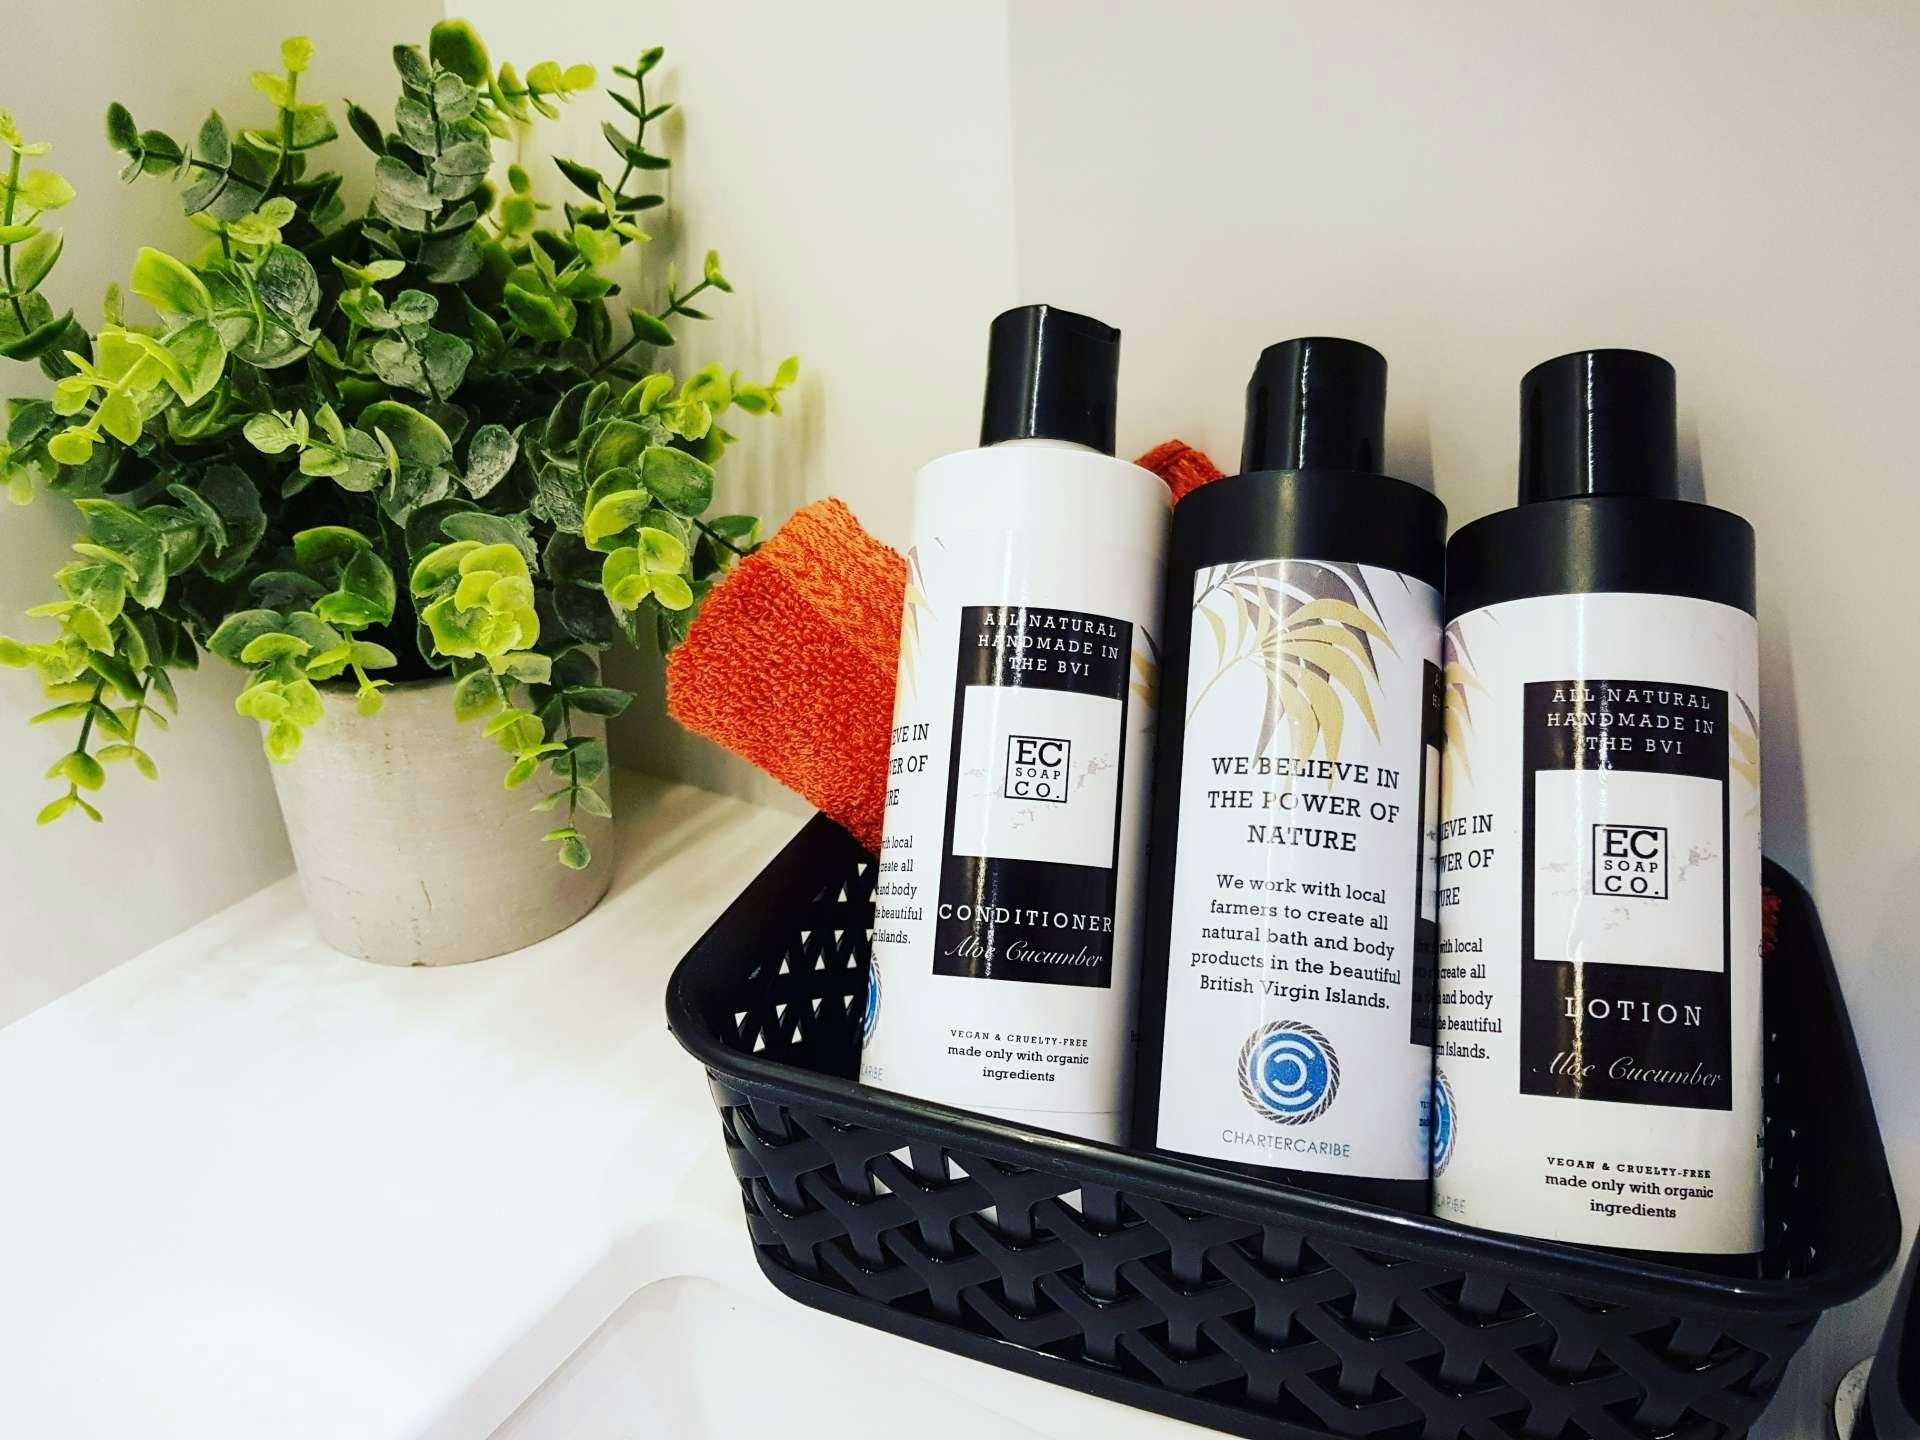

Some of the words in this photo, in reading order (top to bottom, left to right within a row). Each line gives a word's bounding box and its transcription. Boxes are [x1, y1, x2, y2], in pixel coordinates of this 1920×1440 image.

[984, 614, 1020, 627] ALL
[1030, 614, 1117, 637] NATURAL
[978, 635, 1093, 654] HANDMADE
[1102, 645, 1119, 659] IN
[1009, 657, 1047, 671] THE
[1057, 661, 1089, 676] BVI
[1552, 689, 1595, 703] ALL
[1607, 689, 1710, 709] NATURAL
[912, 724, 929, 741] IN
[1548, 713, 1684, 730] HANDMADE
[1695, 719, 1714, 734] IN
[1015, 740, 1062, 767] EC
[1586, 737, 1632, 751] THE
[1646, 739, 1682, 755] BVI
[907, 755, 928, 773] OF
[1015, 767, 1061, 780] SOAP
[1212, 757, 1249, 776] WE
[1257, 757, 1368, 784] BELIEVE
[1376, 768, 1400, 790] IN
[1014, 782, 1060, 799] CO.
[1207, 791, 1253, 809] THE
[1261, 792, 1361, 817] POWER
[1369, 802, 1400, 824] OF
[1472, 814, 1493, 834] IN
[891, 835, 912, 849] local
[1247, 824, 1357, 852] NATURE
[1603, 829, 1658, 859] EC
[900, 859, 913, 872] all
[1468, 849, 1494, 868] OF
[1604, 860, 1658, 873] SOAP
[891, 883, 917, 900] body
[1216, 874, 1244, 890] We
[1249, 873, 1297, 893] work
[1302, 881, 1341, 898] with
[1346, 885, 1386, 904] local
[1604, 875, 1659, 895] CO.
[881, 906, 922, 920] beautiful
[938, 903, 1112, 932] CONDITIONER
[1210, 899, 1277, 917] farmers
[1284, 904, 1301, 919] to
[1307, 907, 1365, 927] create
[1369, 915, 1388, 930] all
[944, 935, 996, 959] Aloe
[1005, 940, 1103, 968] Cucumber
[1201, 926, 1260, 942] natural
[1266, 928, 1308, 947] bath
[1314, 933, 1348, 951] and
[1353, 936, 1395, 961] body
[1455, 938, 1482, 952] local
[1191, 950, 1264, 968] products
[1270, 955, 1288, 971] in
[1294, 957, 1324, 974] the
[1329, 960, 1401, 985] beautiful
[1470, 964, 1486, 978] all
[1200, 974, 1254, 994] British
[1261, 980, 1320, 1001] Virgin
[1325, 987, 1391, 1009] Islands.
[1459, 990, 1493, 1009] body
[1564, 997, 1702, 1026] LOTION
[1448, 1016, 1502, 1033] beautiful
[950, 1029, 989, 1041] VEGAN
[995, 1033, 1001, 1041] &
[1007, 1034, 1088, 1047] CRUELTY-FREE
[947, 1045, 982, 1057] made
[985, 1048, 1012, 1062] only
[1016, 1049, 1043, 1062] with
[1046, 1053, 1089, 1066] organic
[982, 1067, 1055, 1082] ingredients
[1533, 1052, 1595, 1076] Aloe
[1609, 1056, 1721, 1087] Cucumber
[1222, 1130, 1351, 1158] CHARTERCARIBE
[1547, 1157, 1595, 1169] VEGAN
[1602, 1162, 1610, 1170] &
[1617, 1164, 1711, 1179] CRUELTY-FREE
[1545, 1174, 1587, 1188] made
[1592, 1178, 1625, 1195] only
[1629, 1180, 1661, 1195] with
[1664, 1185, 1713, 1200] organic
[1590, 1200, 1676, 1219] ingredients
